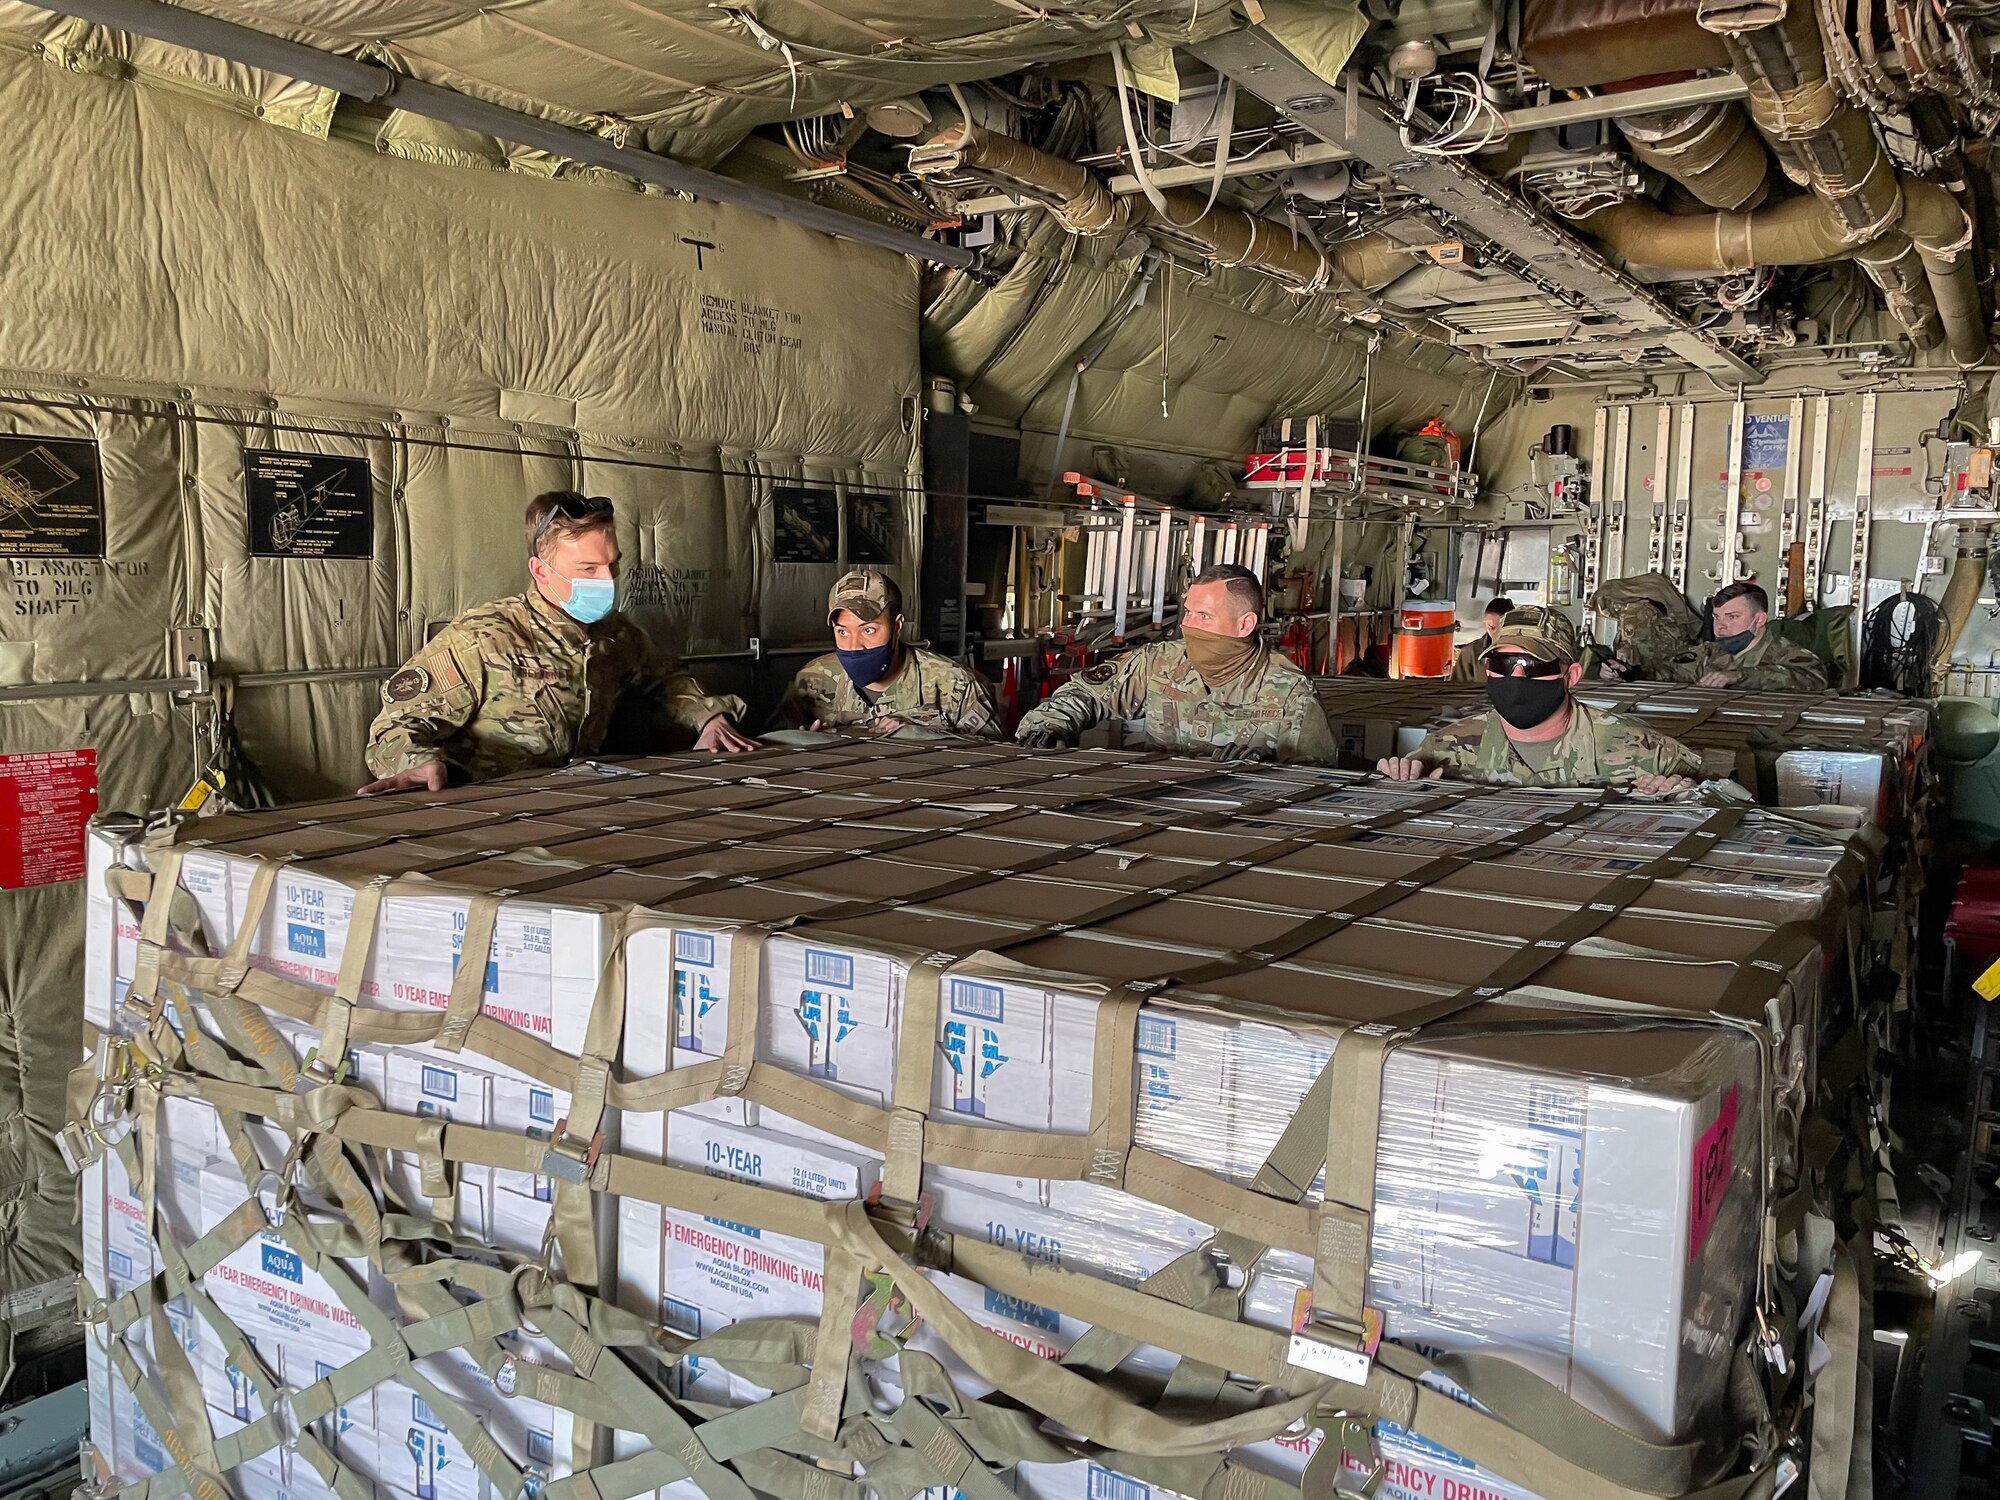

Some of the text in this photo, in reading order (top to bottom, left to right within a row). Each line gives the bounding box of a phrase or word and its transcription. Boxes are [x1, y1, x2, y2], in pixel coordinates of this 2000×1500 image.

[700, 294, 801, 325] REMOVE BLANKET FOR
[701, 308, 776, 332] ACCESS TO MLG
[701, 320, 802, 349] MANUAL CLUTCH GEAR
[744, 342, 761, 355] BOX
[1755, 414, 1790, 423] VENTUR
[12, 561, 149, 577] BLANKET FOR
[14, 580, 92, 596] TO MLG
[15, 599, 79, 616] SHAFT
[287, 886, 324, 908] 10-YEAR
[287, 905, 325, 925] SHELF LIFE
[293, 930, 318, 947] AQUA
[315, 968, 338, 986] DRINK
[393, 983, 403, 998] 10
[405, 985, 427, 1004] YEAR
[483, 1004, 552, 1034] DRINKING WAT
[704, 1140, 762, 1177] 10-YEAR
[793, 1168, 801, 1176] 12
[808, 1172, 827, 1187] LITER)
[828, 1177, 847, 1191] UNITS
[985, 1221, 1061, 1264] 10-YEAR
[267, 1253, 295, 1273] AQUA
[675, 1224, 825, 1293] EMERGENCY DRINKING WAT
[712, 1257, 731, 1270] AQUA
[695, 1261, 769, 1294] WWW.AQUABLOX.COM
[710, 1277, 753, 1299] MADE IN USA
[218, 1265, 239, 1283] YEAR
[240, 1274, 289, 1303] EMERGENCY
[290, 1291, 329, 1318] DRINKING
